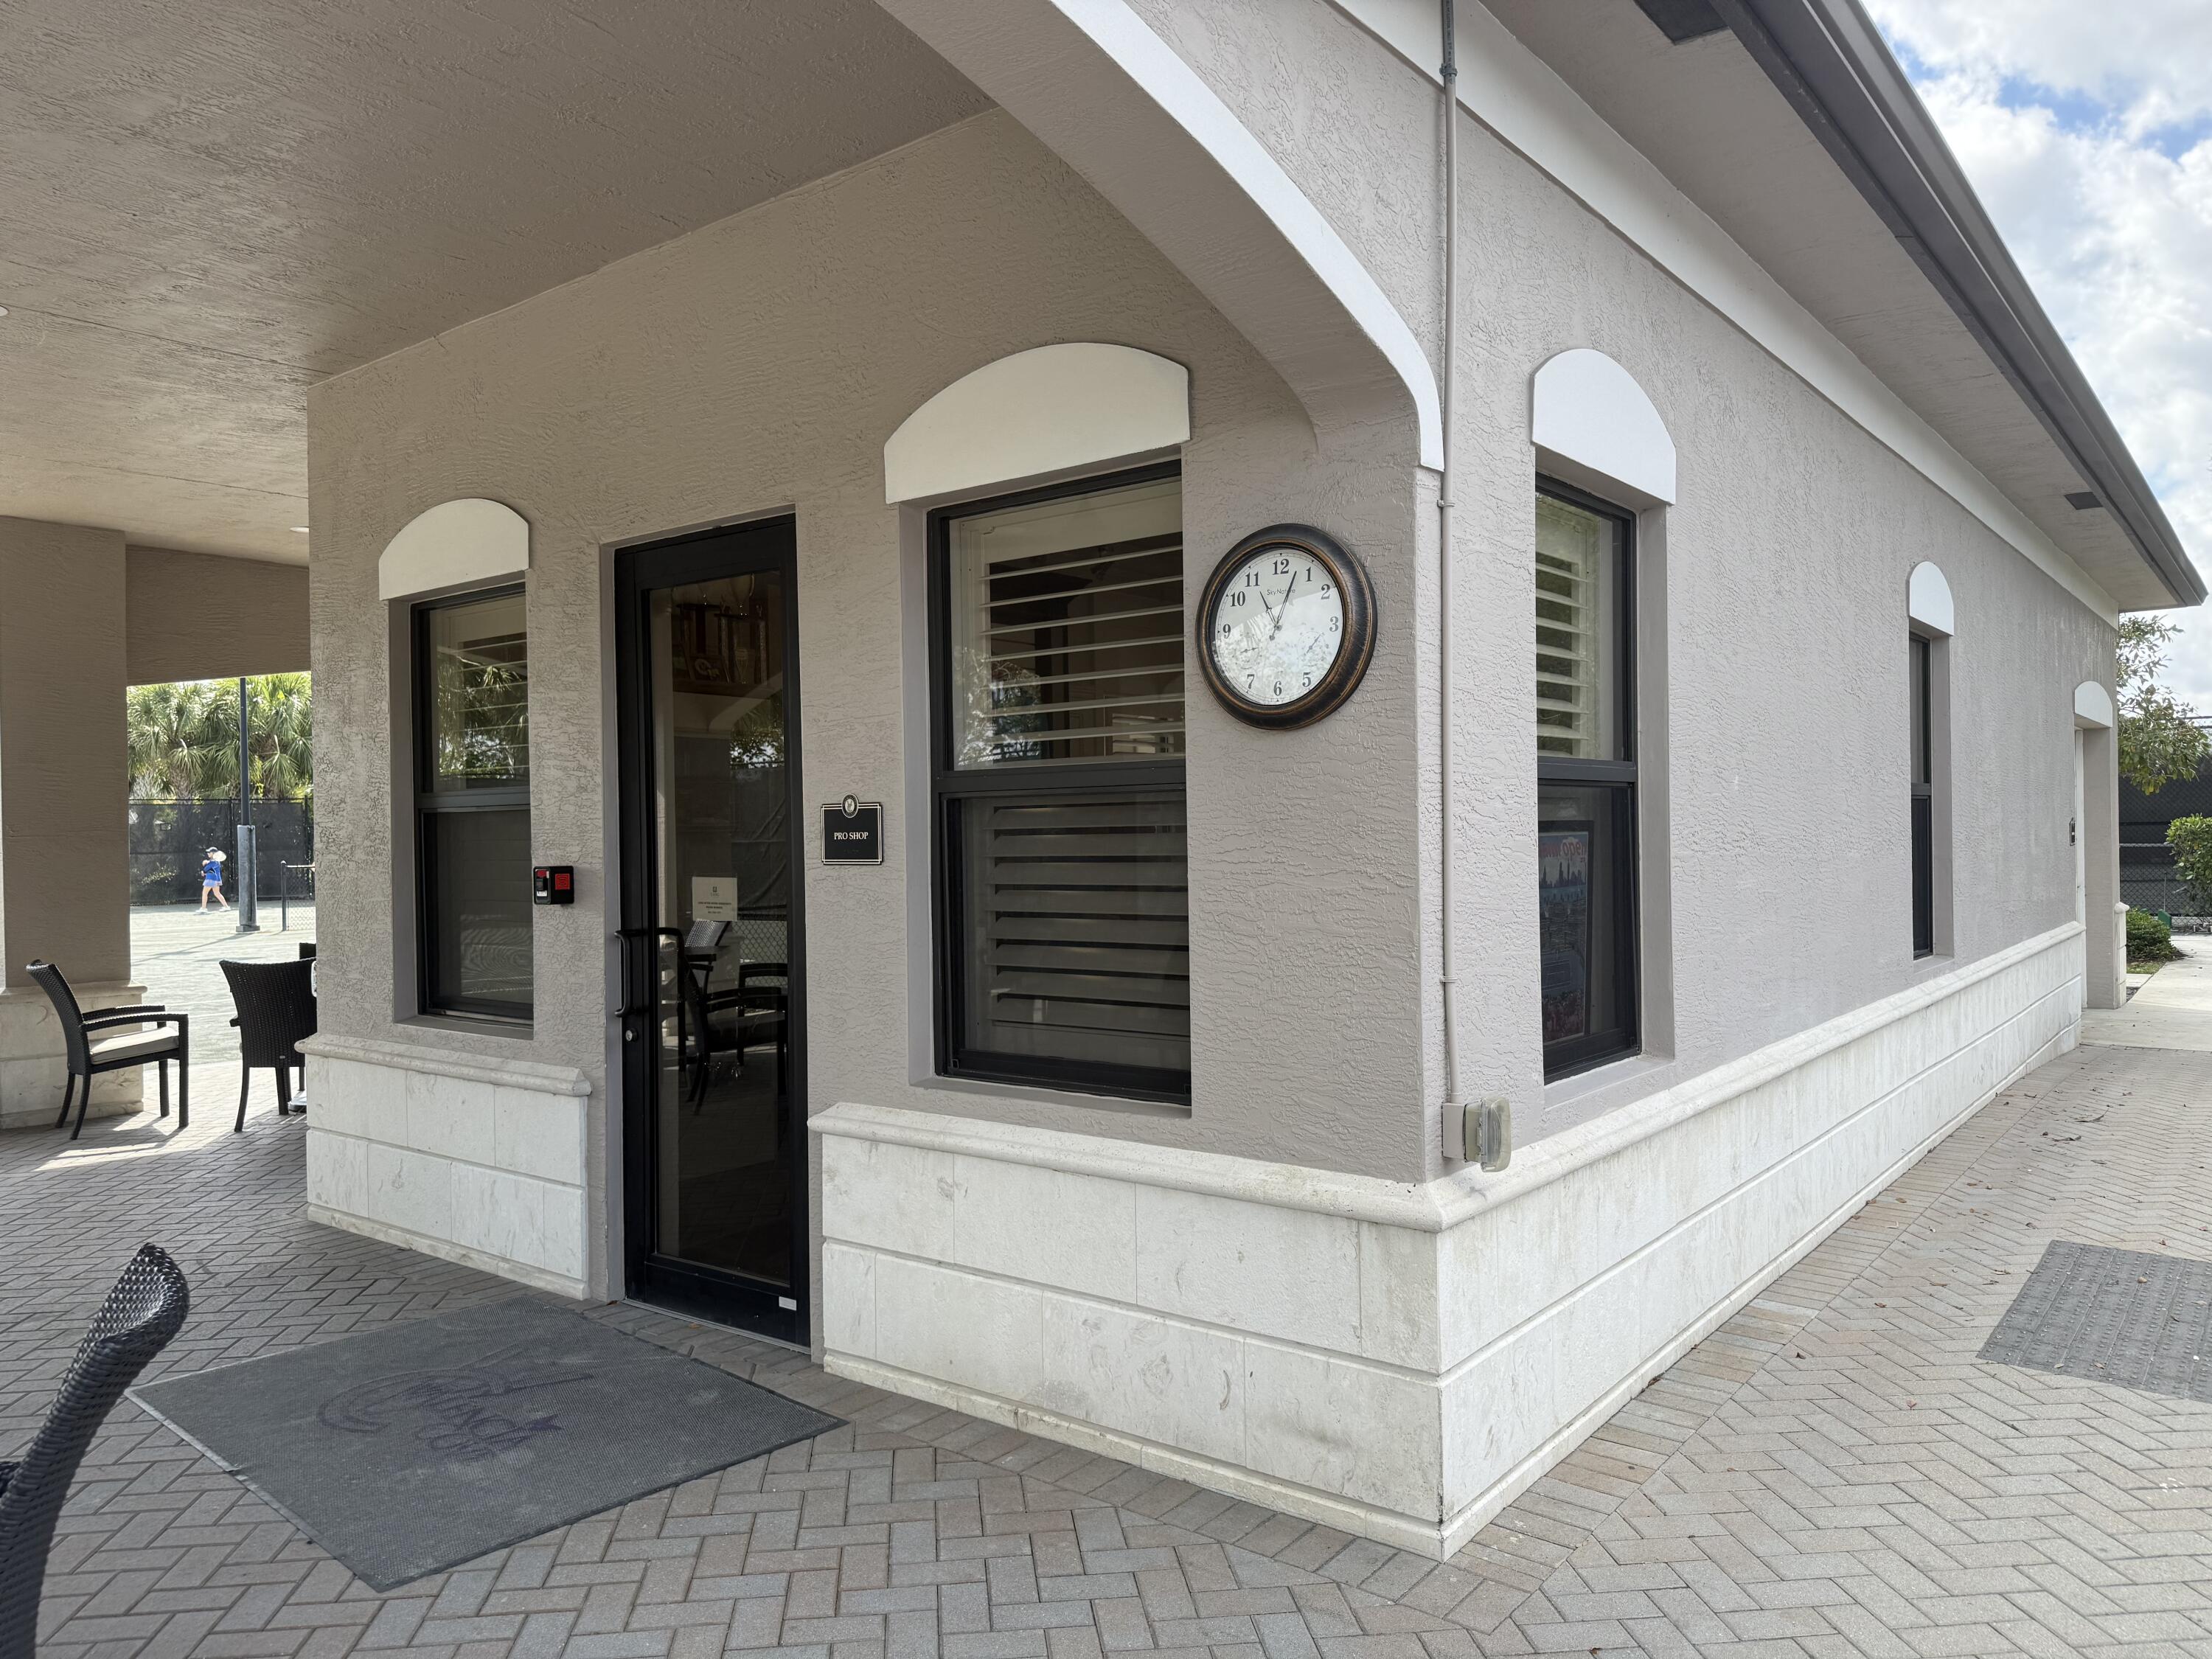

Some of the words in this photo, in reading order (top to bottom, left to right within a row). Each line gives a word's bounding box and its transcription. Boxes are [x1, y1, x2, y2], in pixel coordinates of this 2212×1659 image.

[1273, 559, 1290, 575] 12
[1306, 567, 1312, 582] 1
[1245, 571, 1259, 587] 11
[1230, 591, 1246, 607] 10
[1321, 584, 1330, 599] 2
[1222, 624, 1231, 639] 9
[1329, 616, 1339, 632] 3
[1247, 674, 1255, 689] 7
[1302, 672, 1312, 687] 5
[1273, 681, 1282, 696] 6
[834, 832, 848, 840] PRO
[849, 832, 869, 840] SHOP
